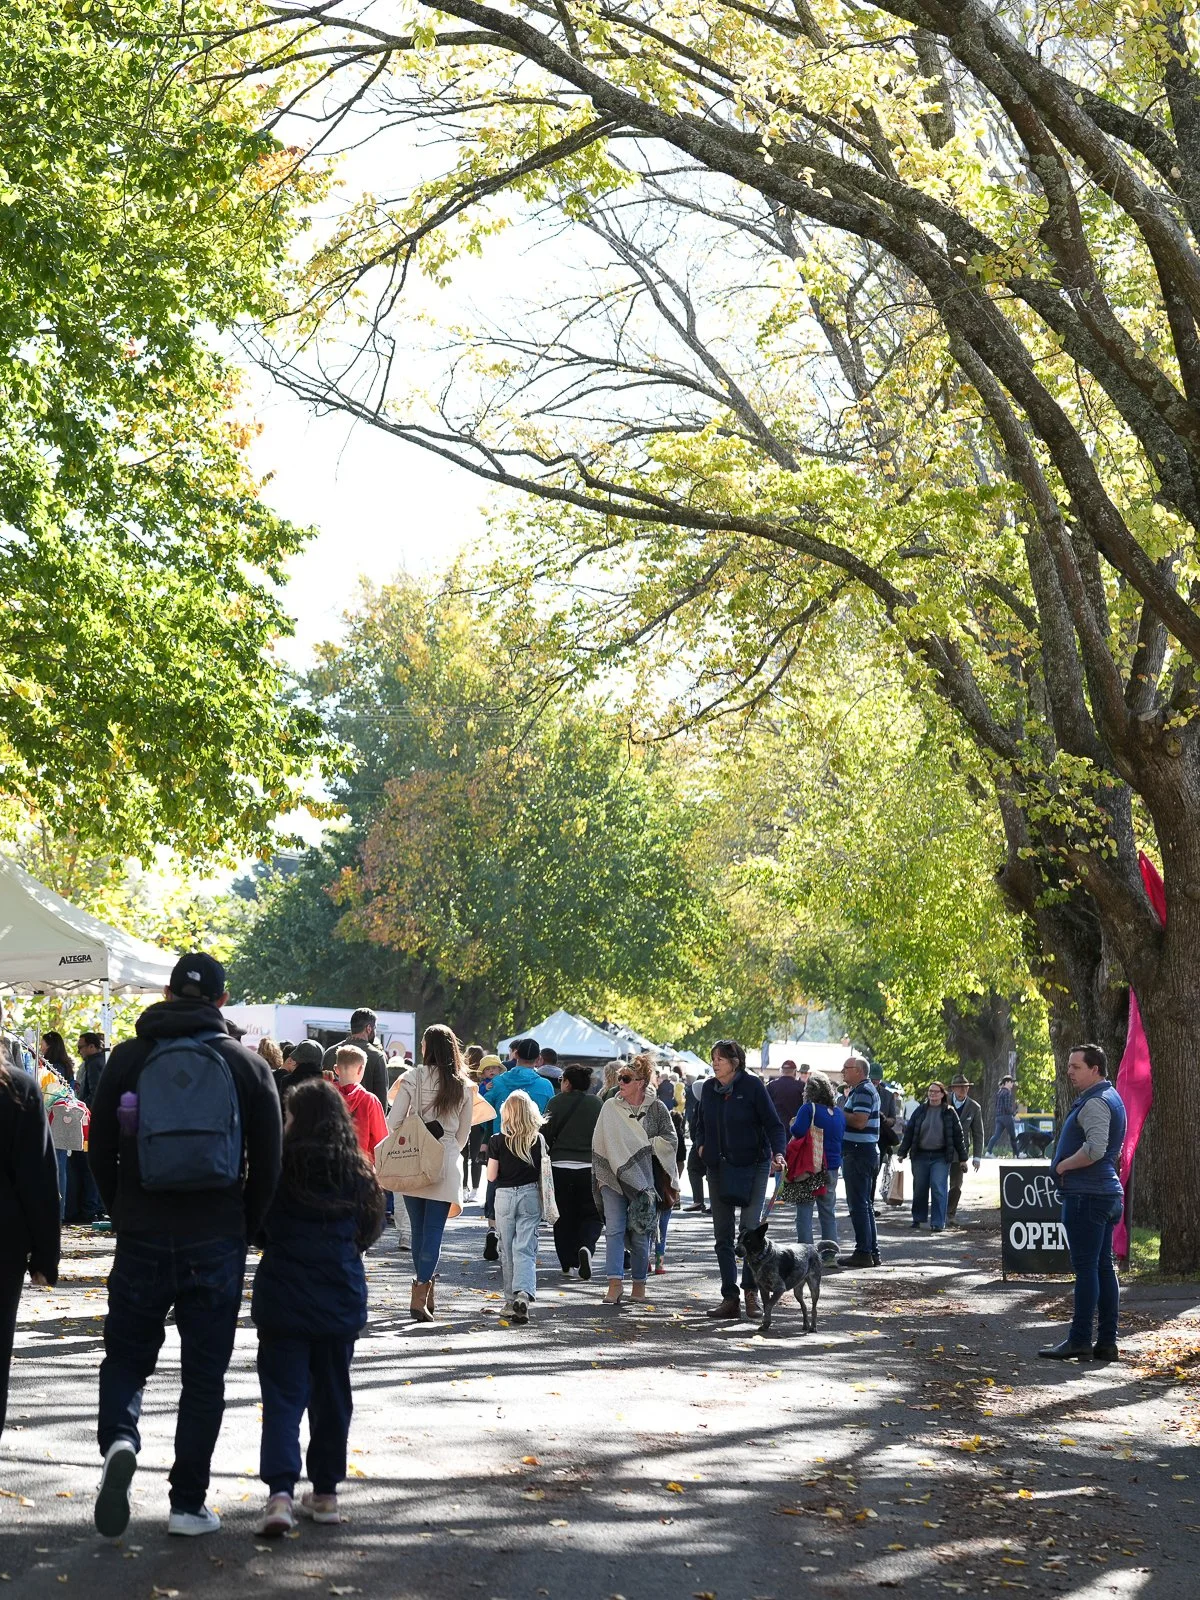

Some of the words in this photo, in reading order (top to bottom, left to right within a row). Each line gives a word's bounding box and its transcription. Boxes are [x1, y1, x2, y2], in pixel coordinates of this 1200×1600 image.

[58, 954, 93, 966] ALTEGRA
[1003, 1172, 1064, 1209] Coffe
[1009, 1221, 1071, 1250] OPEN
